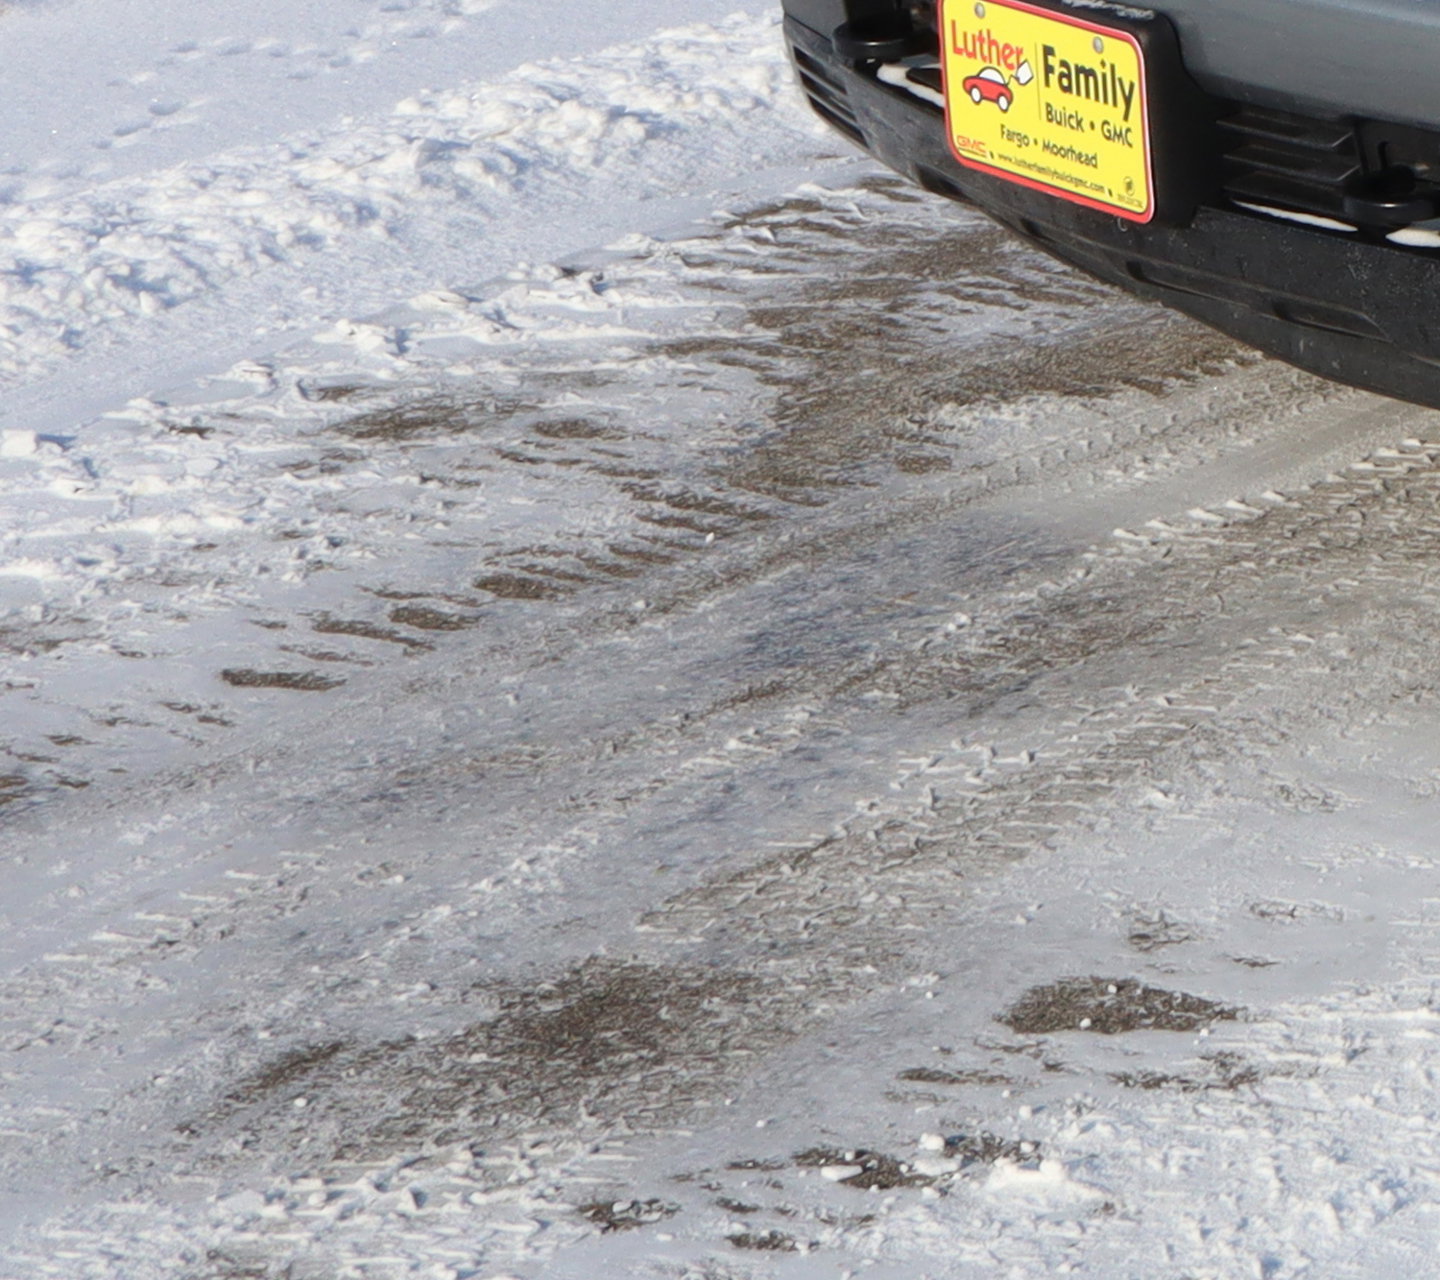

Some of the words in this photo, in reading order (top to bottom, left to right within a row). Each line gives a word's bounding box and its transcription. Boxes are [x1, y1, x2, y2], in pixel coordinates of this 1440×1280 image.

[951, 19, 1023, 71] Luther
[1042, 44, 1135, 122] Family
[957, 134, 987, 154] GMC
[1000, 124, 1030, 149] Fargo
[1042, 138, 1098, 169] Moorhead
[1045, 102, 1084, 133] Buick
[1101, 120, 1133, 148] GMC
